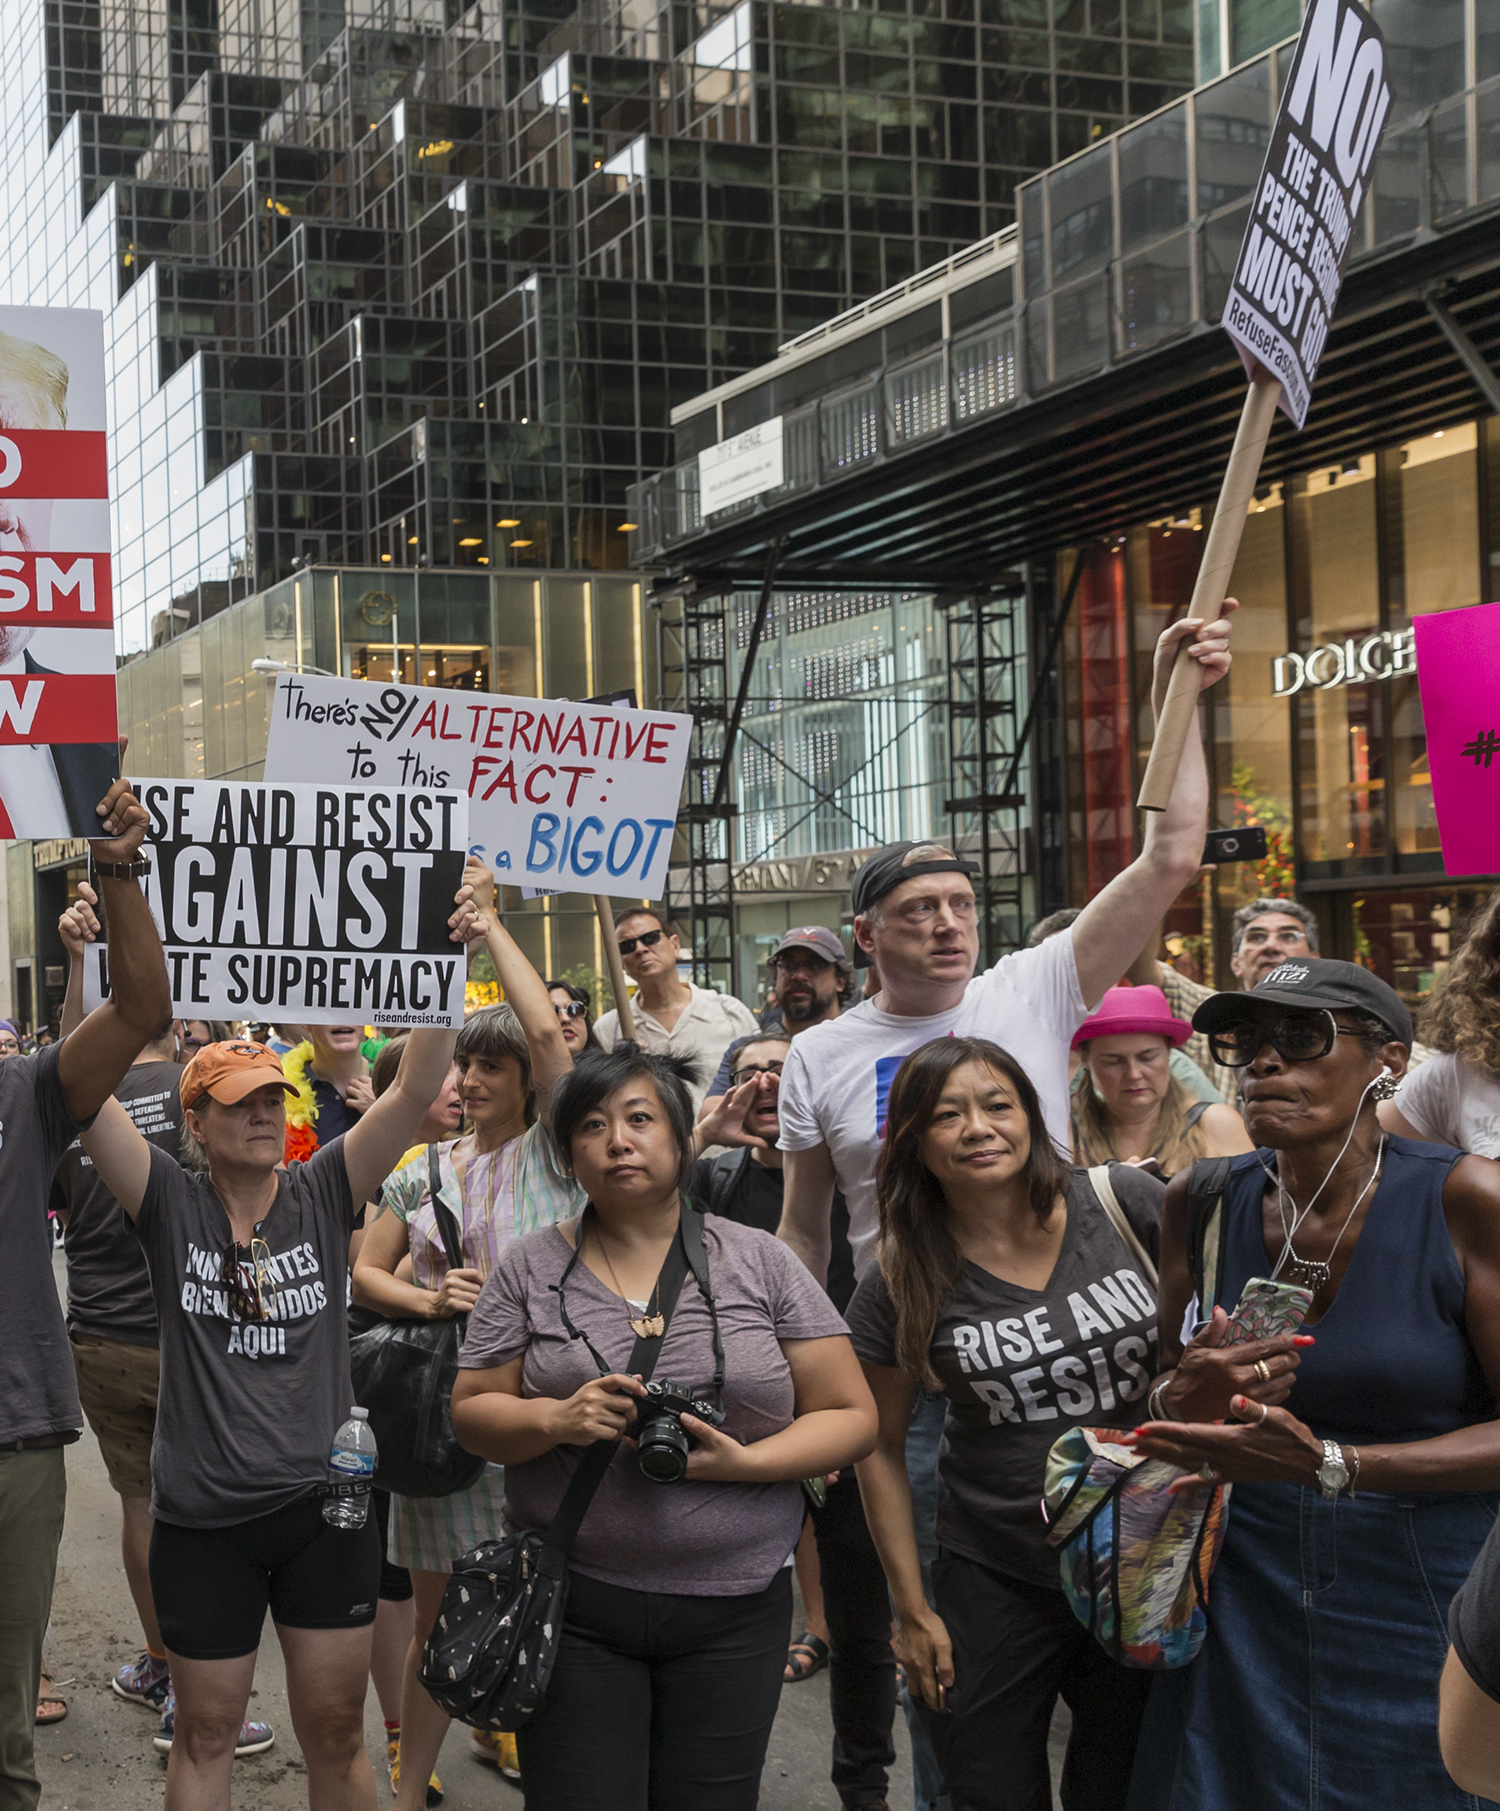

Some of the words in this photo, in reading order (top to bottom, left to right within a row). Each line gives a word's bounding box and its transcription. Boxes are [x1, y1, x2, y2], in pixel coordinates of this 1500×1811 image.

[1281, 132, 1319, 200] THE
[1257, 171, 1315, 259] PENCE
[1239, 222, 1315, 339] MUST
[1272, 626, 1417, 698] DOLCE
[279, 677, 359, 727] There's
[411, 699, 677, 763] ALTERNATIVE
[347, 741, 377, 779] to
[398, 748, 451, 788] this
[211, 788, 297, 845] AND
[315, 791, 458, 850] RESIST
[526, 812, 675, 880] BIGOT
[496, 849, 512, 870] a
[227, 954, 456, 1012] SUPREMACY
[374, 1011, 452, 1028] riseandresist.org
[133, 1092, 164, 1107] COMMITTED
[164, 1091, 172, 1099] TO
[135, 1103, 164, 1117] DEFEATING
[135, 1112, 166, 1125] THREATENS
[227, 1325, 286, 1361] AQUI
[952, 1306, 1065, 1373] RISE
[1067, 1269, 1157, 1341] AND
